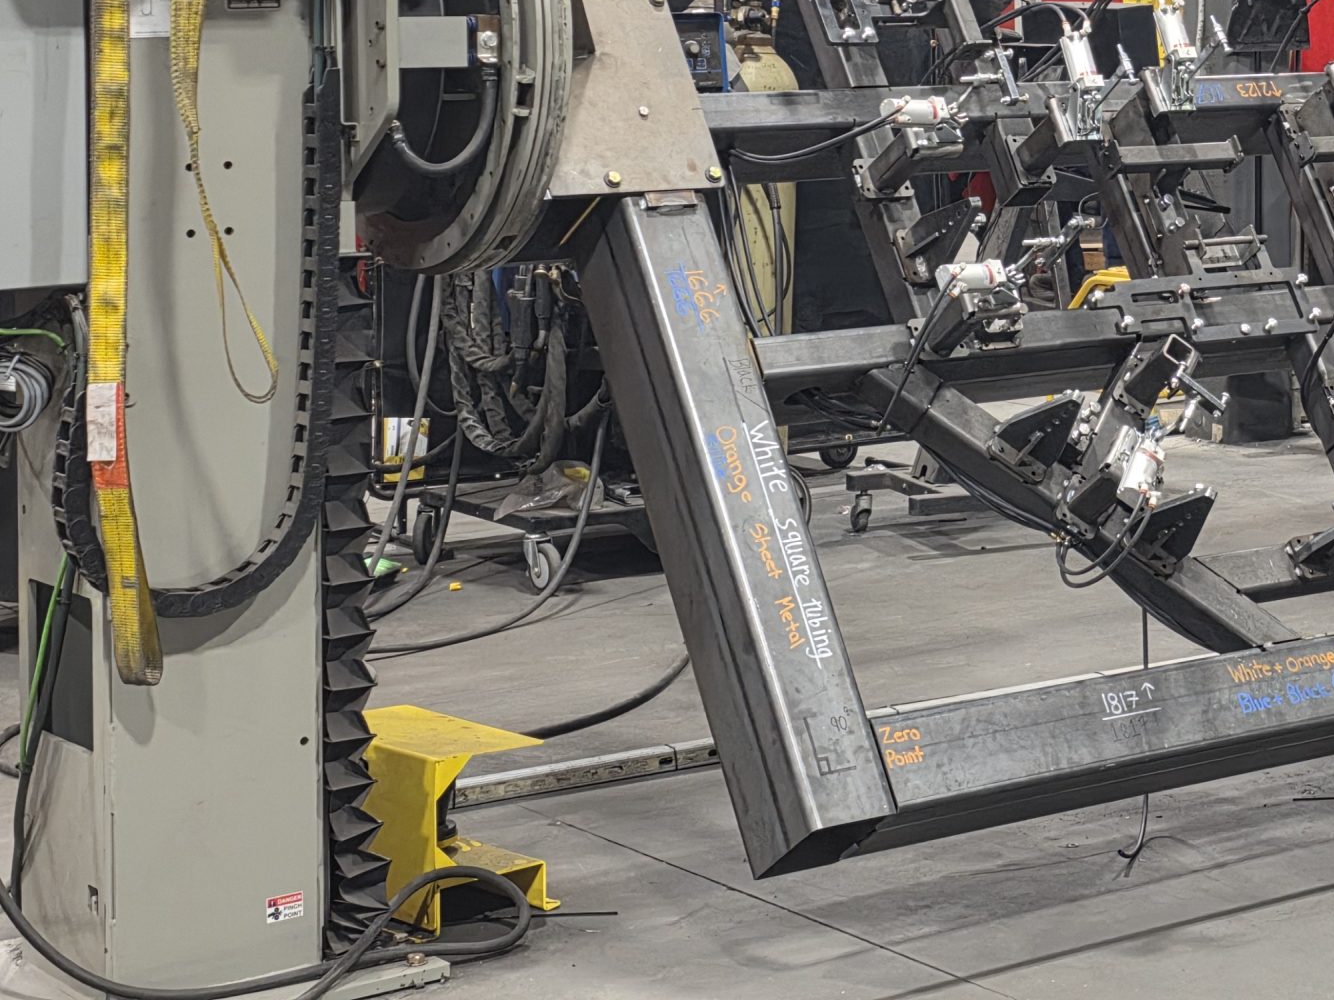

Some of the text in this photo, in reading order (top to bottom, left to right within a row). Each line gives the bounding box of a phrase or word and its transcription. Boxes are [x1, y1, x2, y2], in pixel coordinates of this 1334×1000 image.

[685, 270, 721, 324] 1666
[750, 420, 788, 492] White
[716, 425, 806, 649] Orange Sheet Metal
[1227, 660, 1272, 683] White
[1101, 690, 1140, 714] 1817
[879, 726, 921, 745] Zero
[885, 748, 925, 769] Point
[283, 910, 302, 919] POINT
